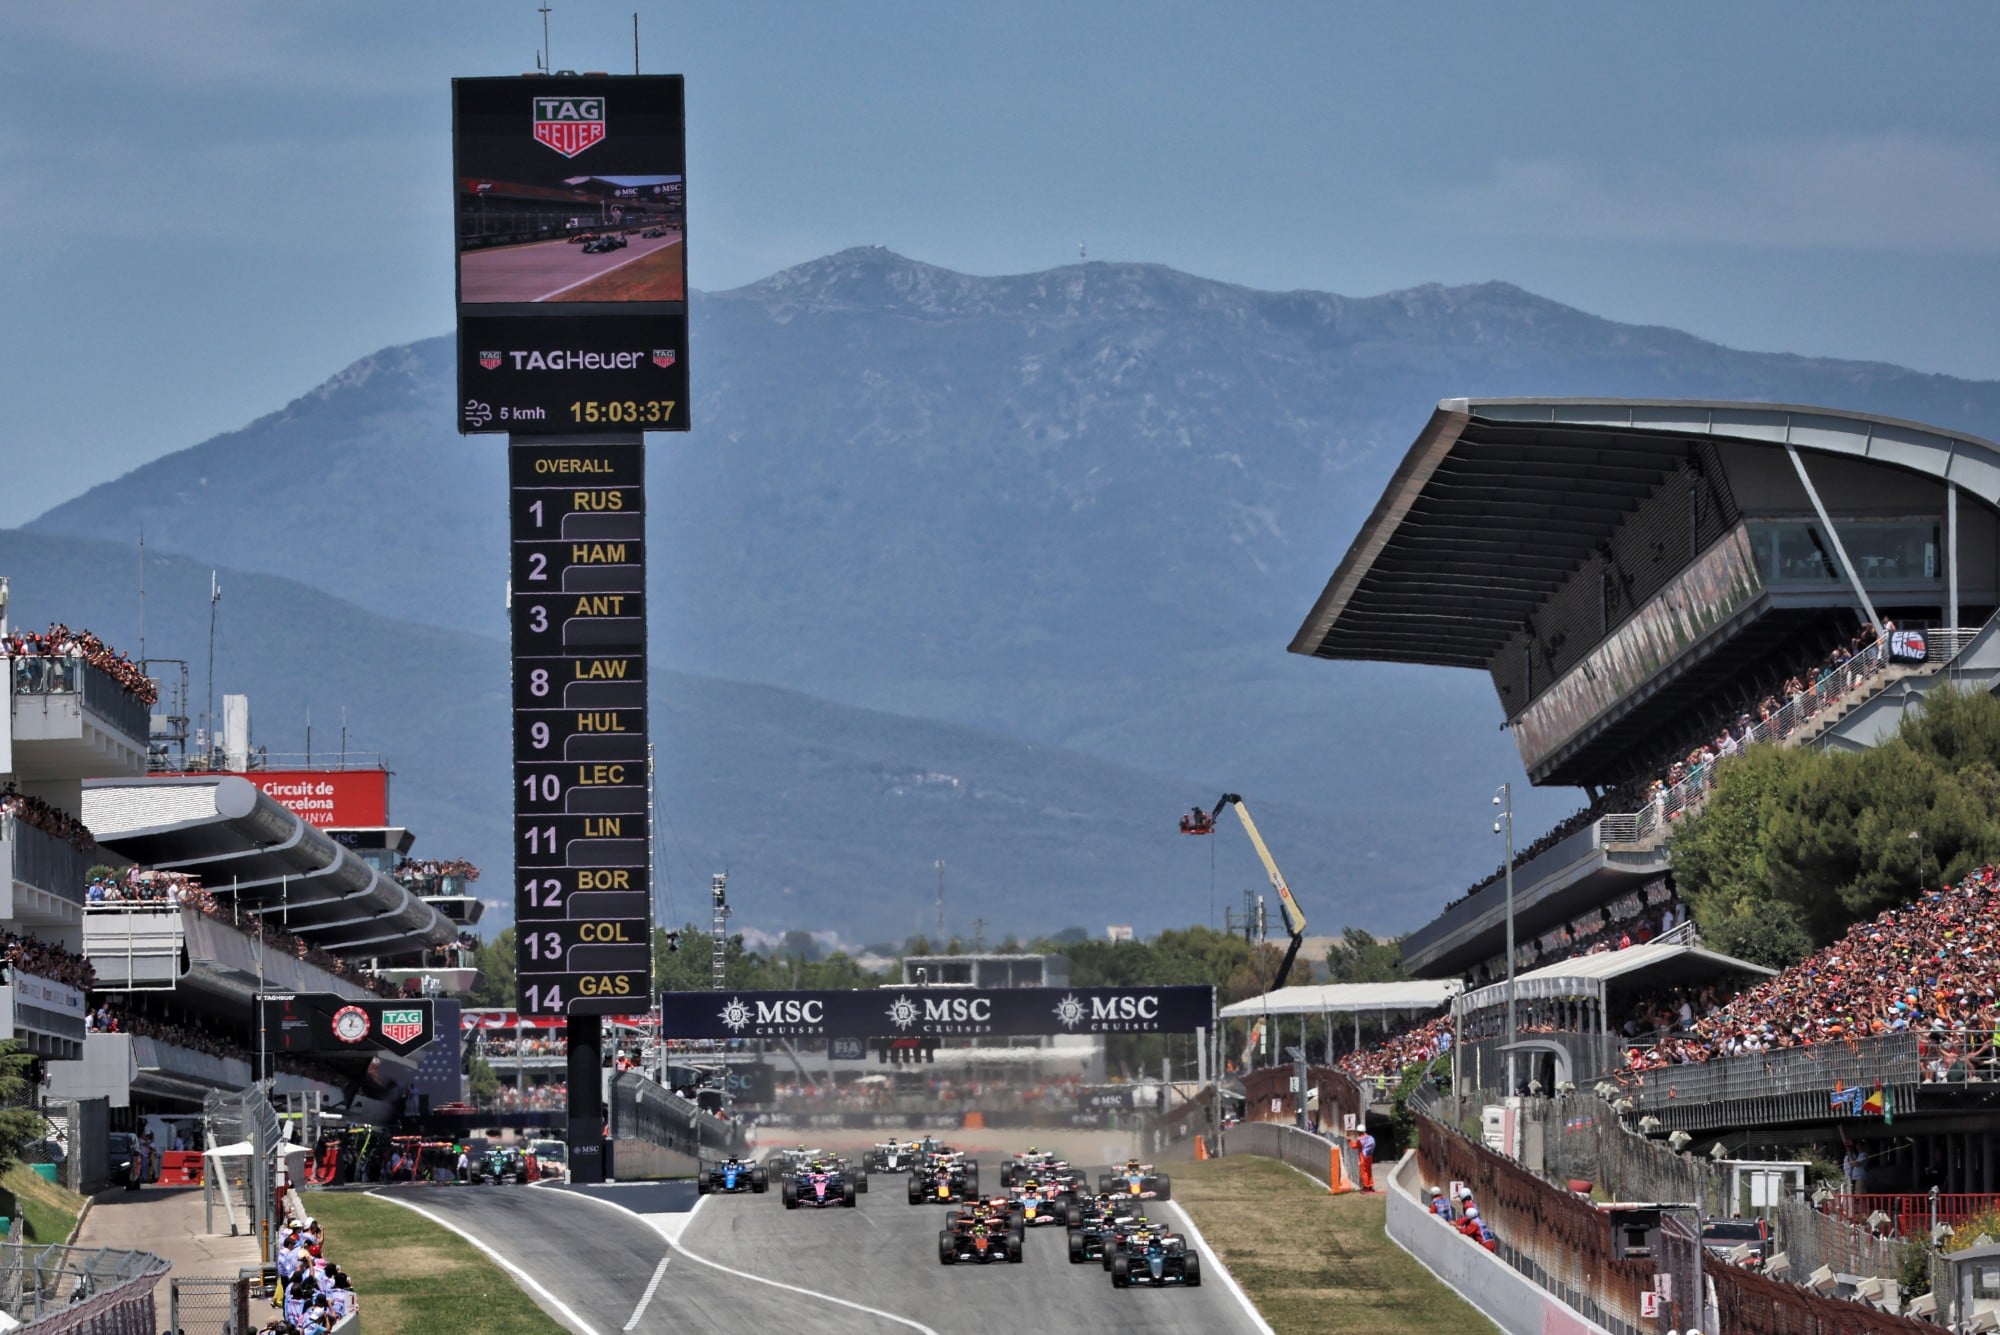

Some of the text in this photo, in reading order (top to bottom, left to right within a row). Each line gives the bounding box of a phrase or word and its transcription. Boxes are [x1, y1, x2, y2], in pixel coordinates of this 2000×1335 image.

[539, 101, 598, 119] TAG
[538, 124, 600, 153] HEUER
[509, 350, 645, 370] TAGHeuer
[500, 406, 546, 420] 5 kmh
[570, 401, 676, 422] 15:03:37
[535, 458, 614, 473] OVERALL
[528, 491, 624, 527] 1 RUS
[528, 544, 626, 580] 2 HAM
[529, 596, 625, 632] 3 ANT
[530, 660, 627, 697] 8 LAW
[531, 713, 625, 749] 9 HUL
[263, 781, 334, 795] Circuit de
[523, 765, 625, 801] 10 LEC
[524, 818, 621, 854] 11 LIN
[524, 870, 630, 907] 12 BOR
[524, 923, 629, 960] 13 COL
[525, 975, 630, 1012] 14 GAS
[385, 1012, 419, 1023] TAG
[755, 1000, 824, 1023] MSC
[923, 998, 991, 1021] MSC
[1091, 996, 1158, 1019] MSC
[384, 1025, 420, 1040] HEUER
[756, 1026, 824, 1034] CRUISES
[1091, 1022, 1158, 1031] CRUISES
[834, 1041, 859, 1053] FIA
[1102, 1096, 1121, 1104] MSC
